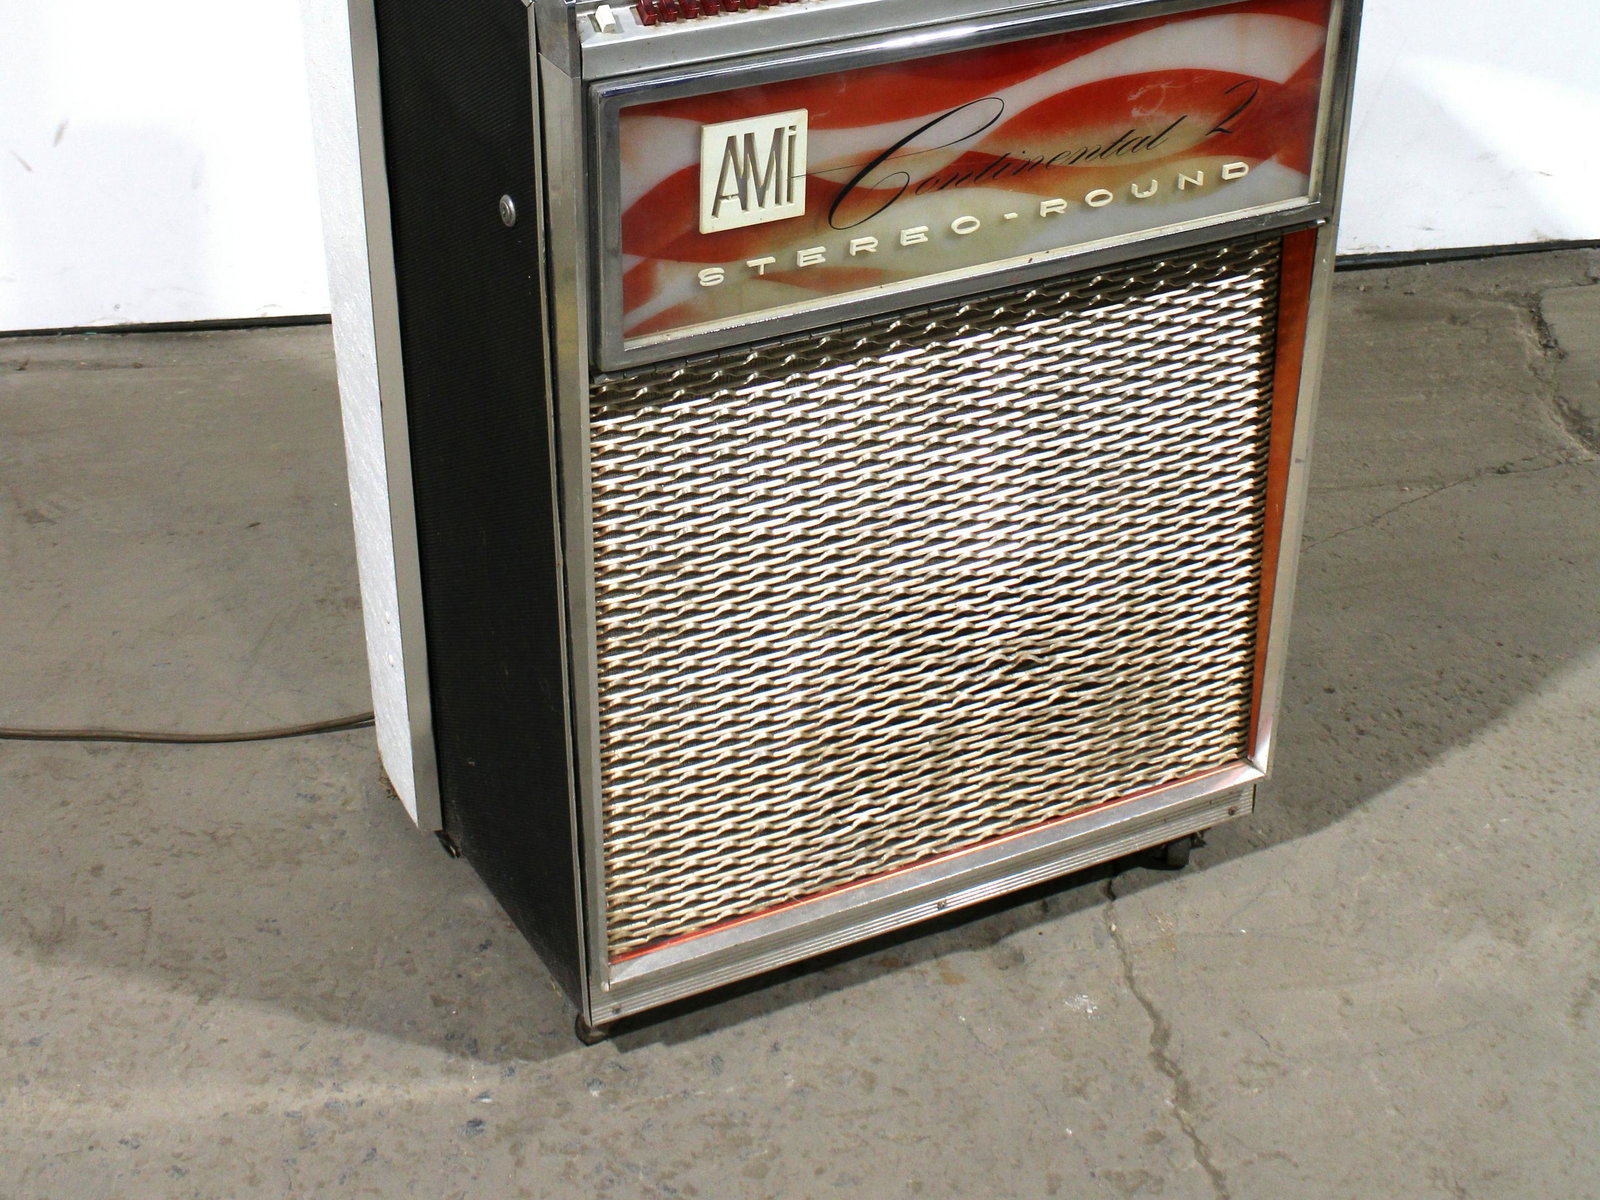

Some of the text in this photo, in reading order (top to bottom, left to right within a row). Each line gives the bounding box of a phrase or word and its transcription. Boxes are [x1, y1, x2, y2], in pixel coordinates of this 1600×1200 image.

[698, 160, 1251, 288] STEREO-ROUND
[793, 80, 1261, 231] Continental 2
